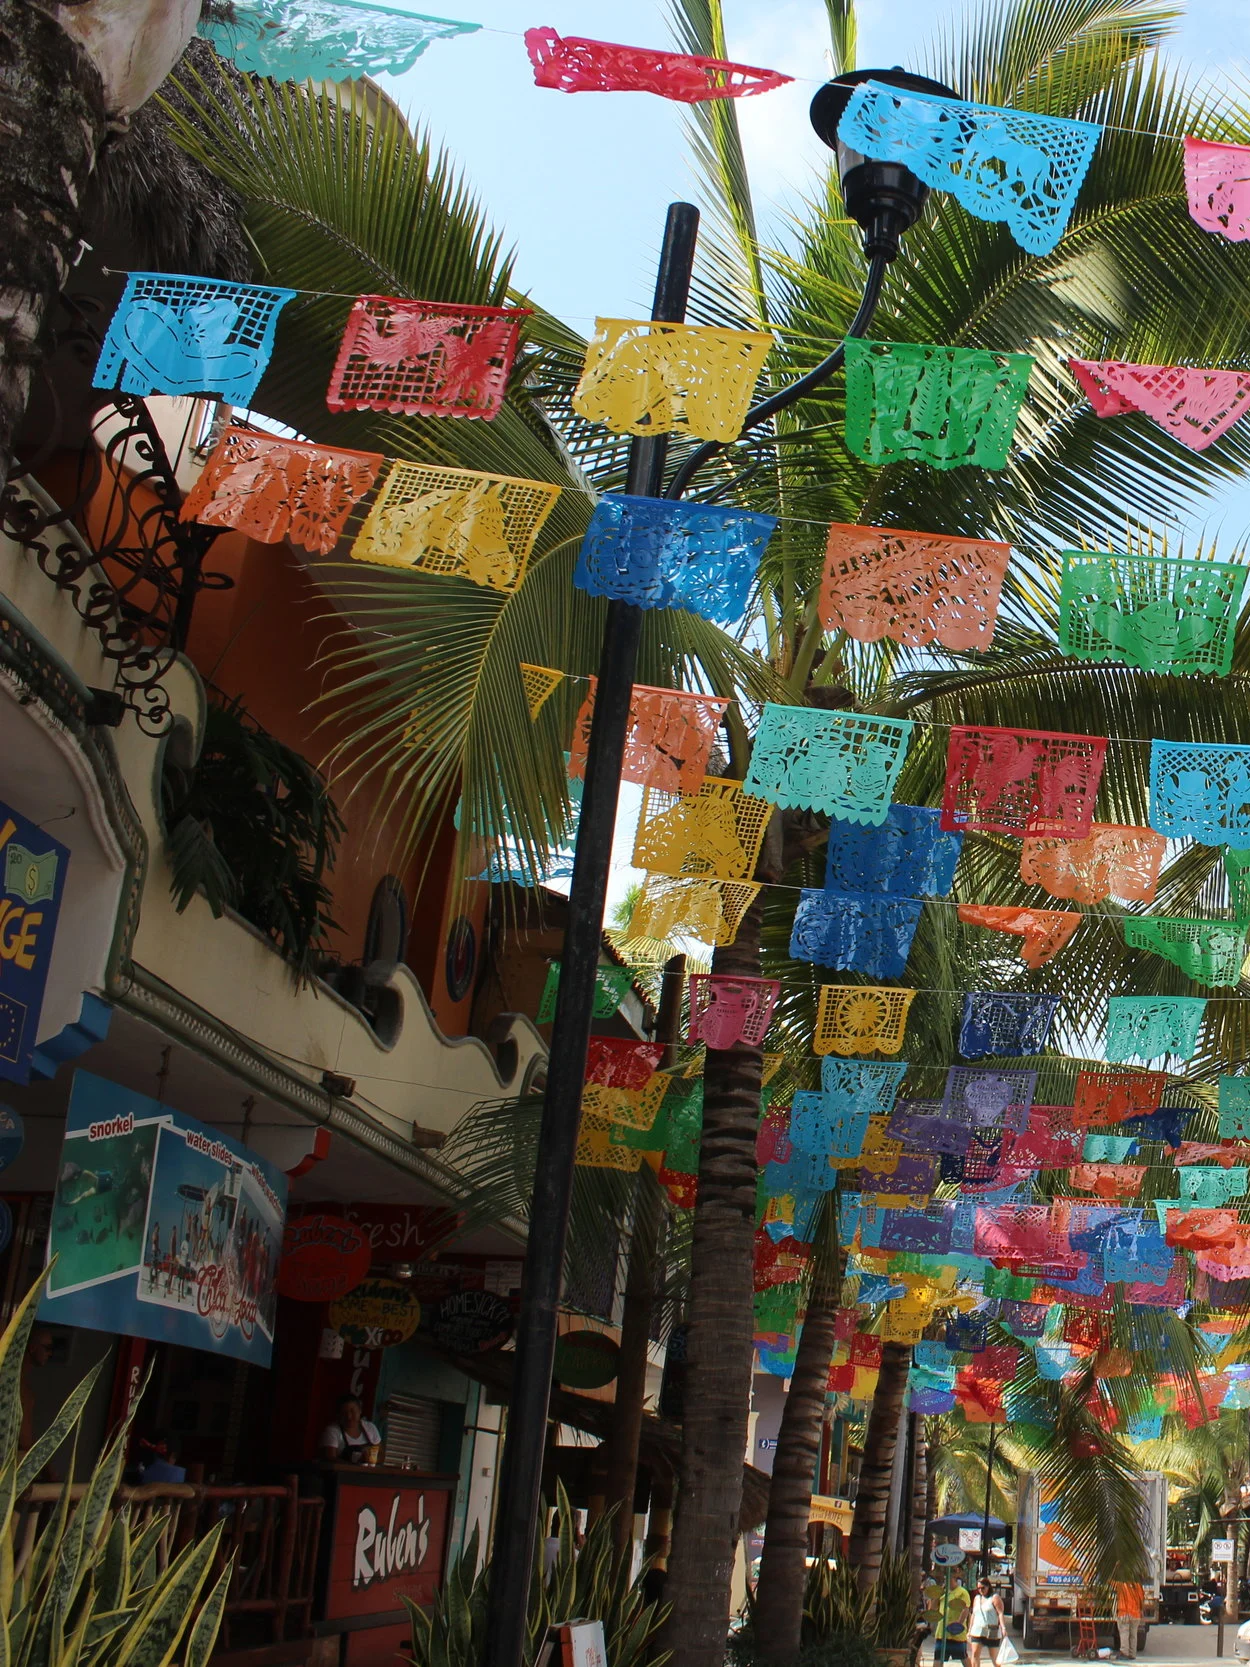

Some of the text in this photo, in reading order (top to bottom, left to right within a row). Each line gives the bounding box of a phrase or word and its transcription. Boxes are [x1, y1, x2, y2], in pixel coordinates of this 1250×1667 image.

[89, 1114, 133, 1140] snorkel
[187, 1131, 233, 1165] water slides
[383, 1303, 417, 1317] BEST
[353, 1494, 430, 1587] Ruben's
